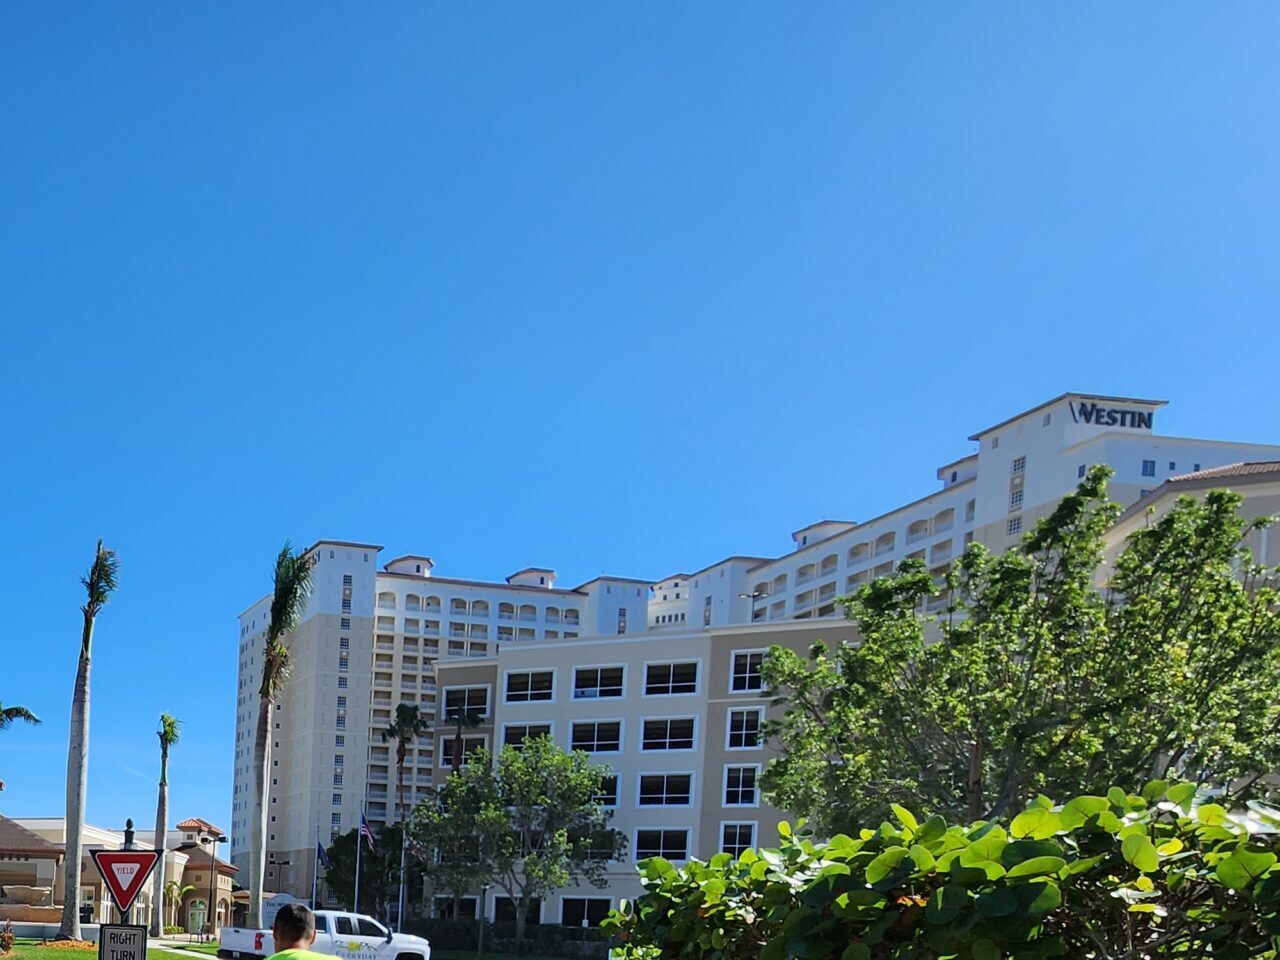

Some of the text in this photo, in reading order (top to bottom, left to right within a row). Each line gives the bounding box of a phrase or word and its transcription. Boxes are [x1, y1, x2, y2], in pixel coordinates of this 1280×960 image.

[1069, 401, 1153, 429] WESTIN
[116, 867, 135, 875] YIELD
[109, 933, 137, 945] RIGHT
[335, 950, 377, 960] EVERYDAY
